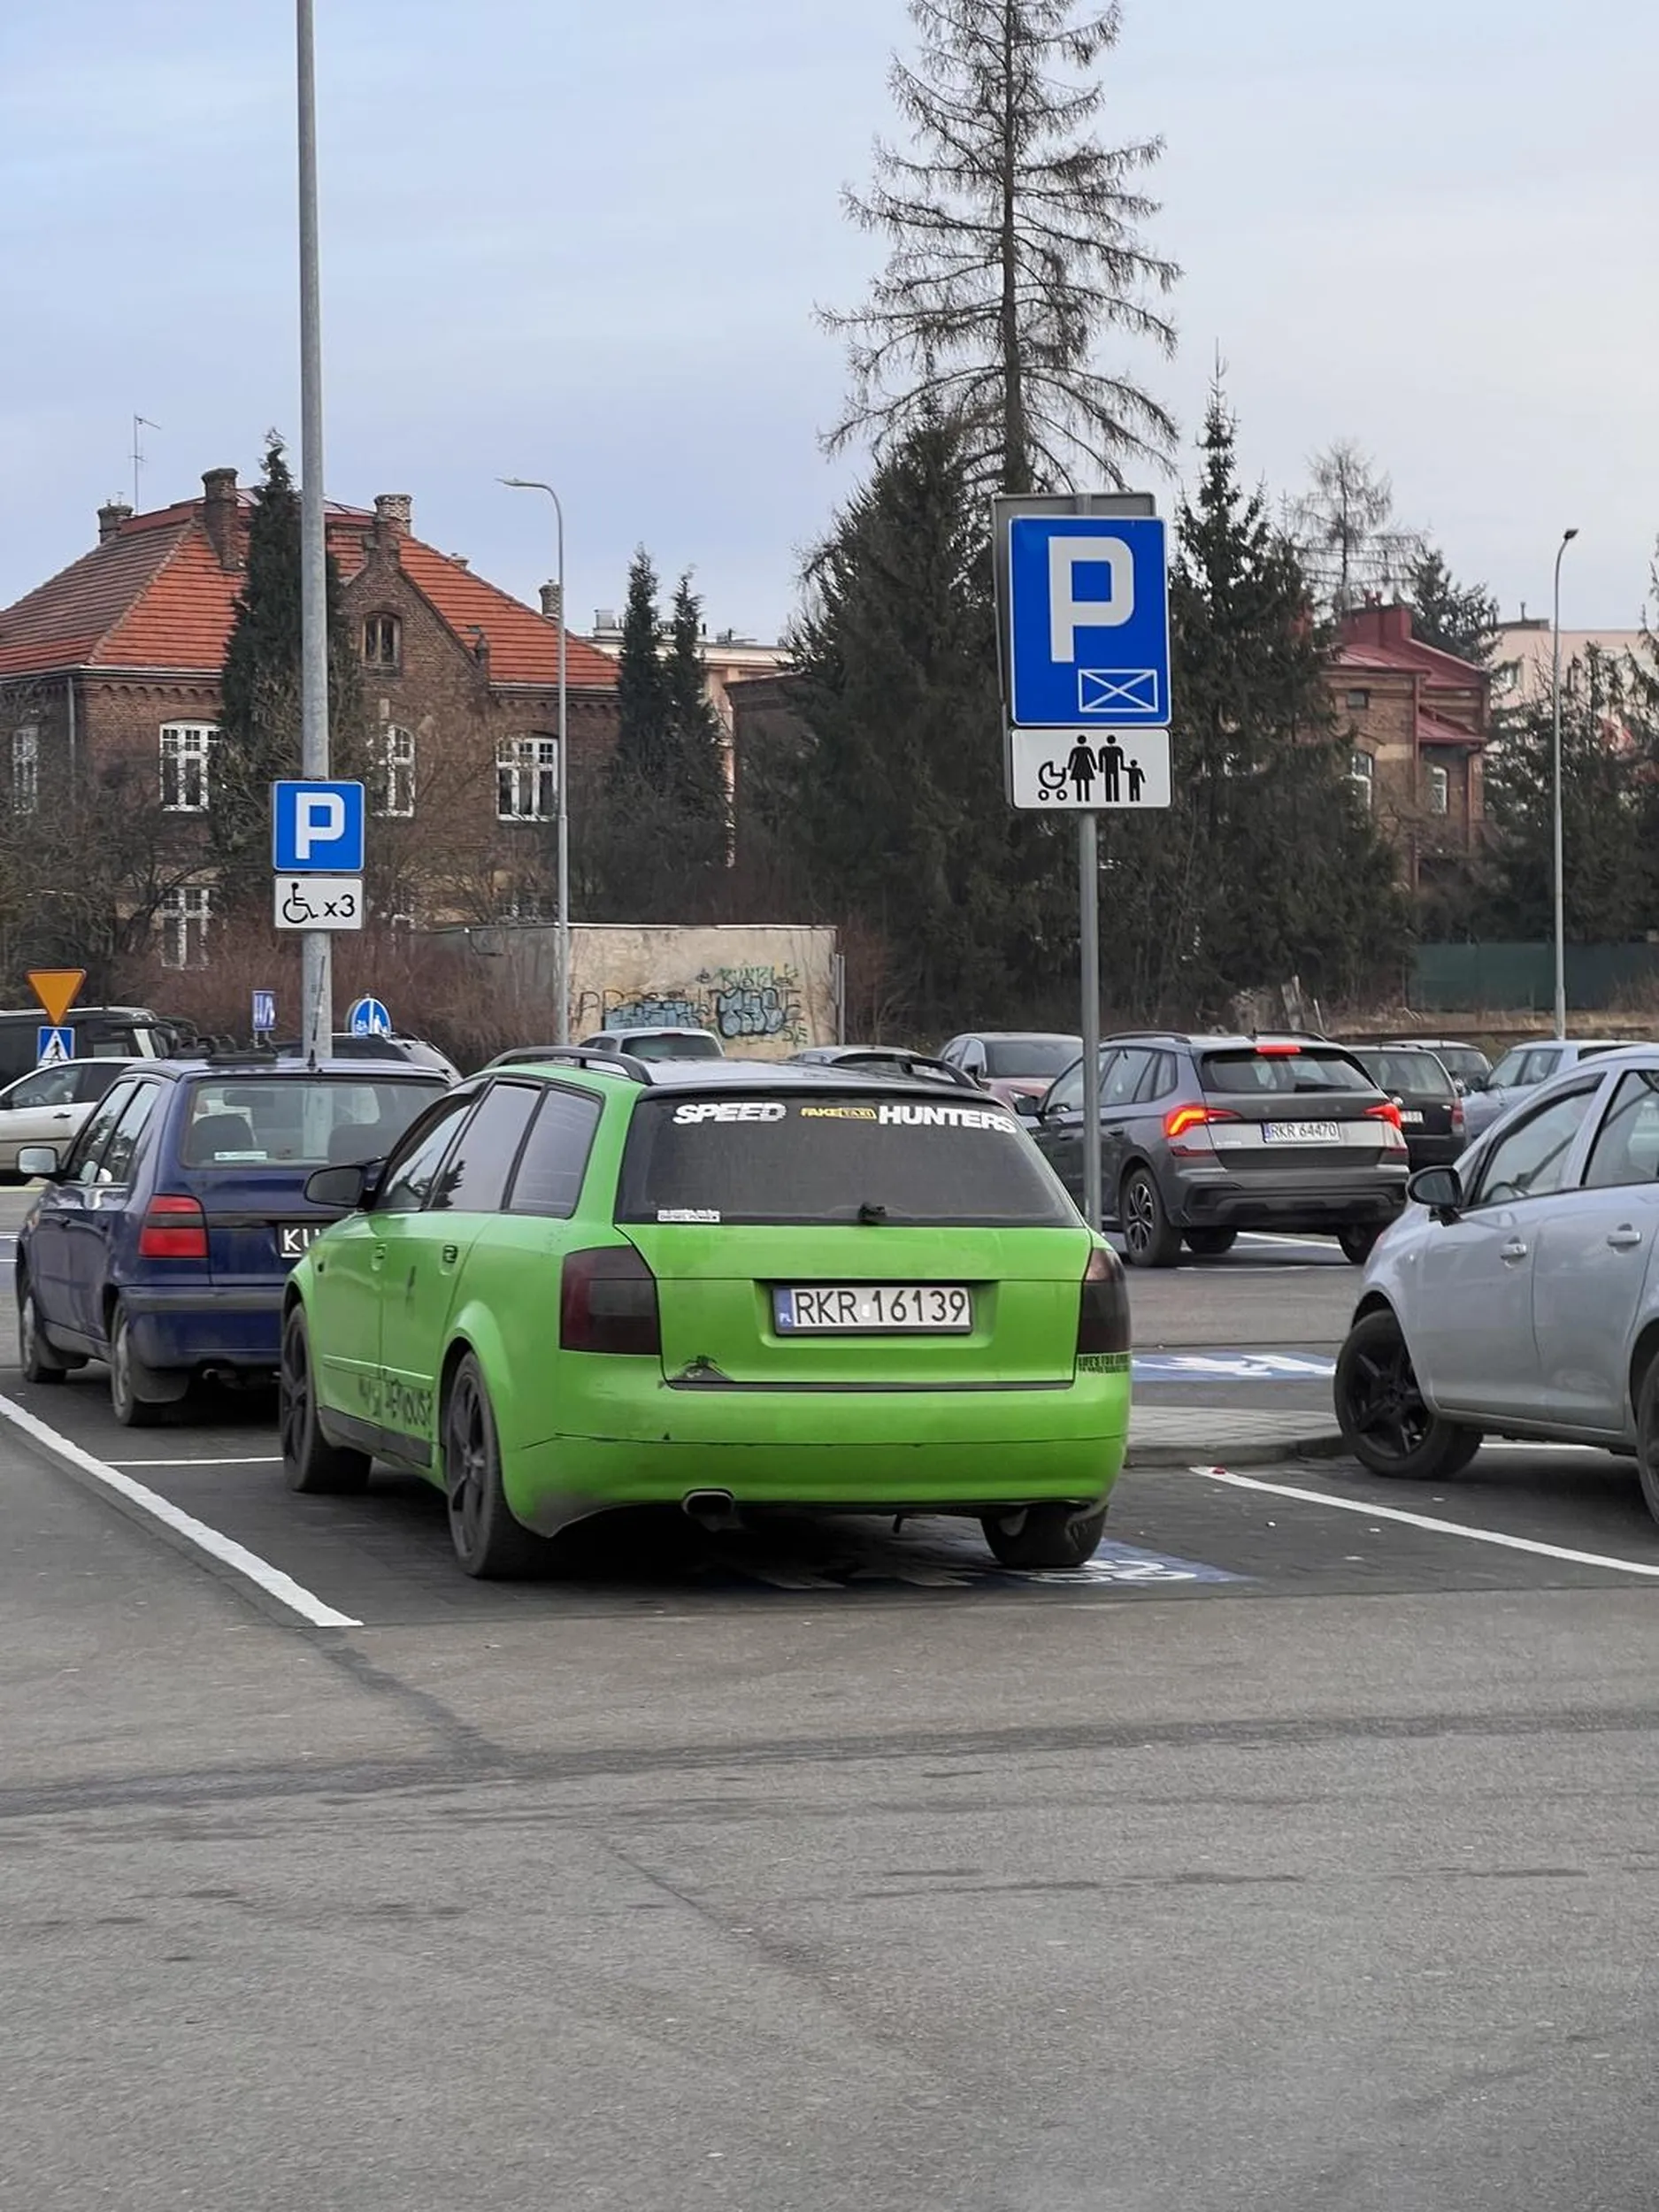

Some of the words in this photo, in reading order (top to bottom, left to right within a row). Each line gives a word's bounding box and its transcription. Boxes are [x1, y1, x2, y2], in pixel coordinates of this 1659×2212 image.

[1048, 536, 1134, 663] P
[296, 792, 345, 859] P
[324, 894, 355, 918] x3
[672, 1102, 787, 1125] SPEED
[879, 1105, 1017, 1133] HUNTERS
[795, 1291, 858, 1324] RKR
[872, 1290, 965, 1322] 16139
